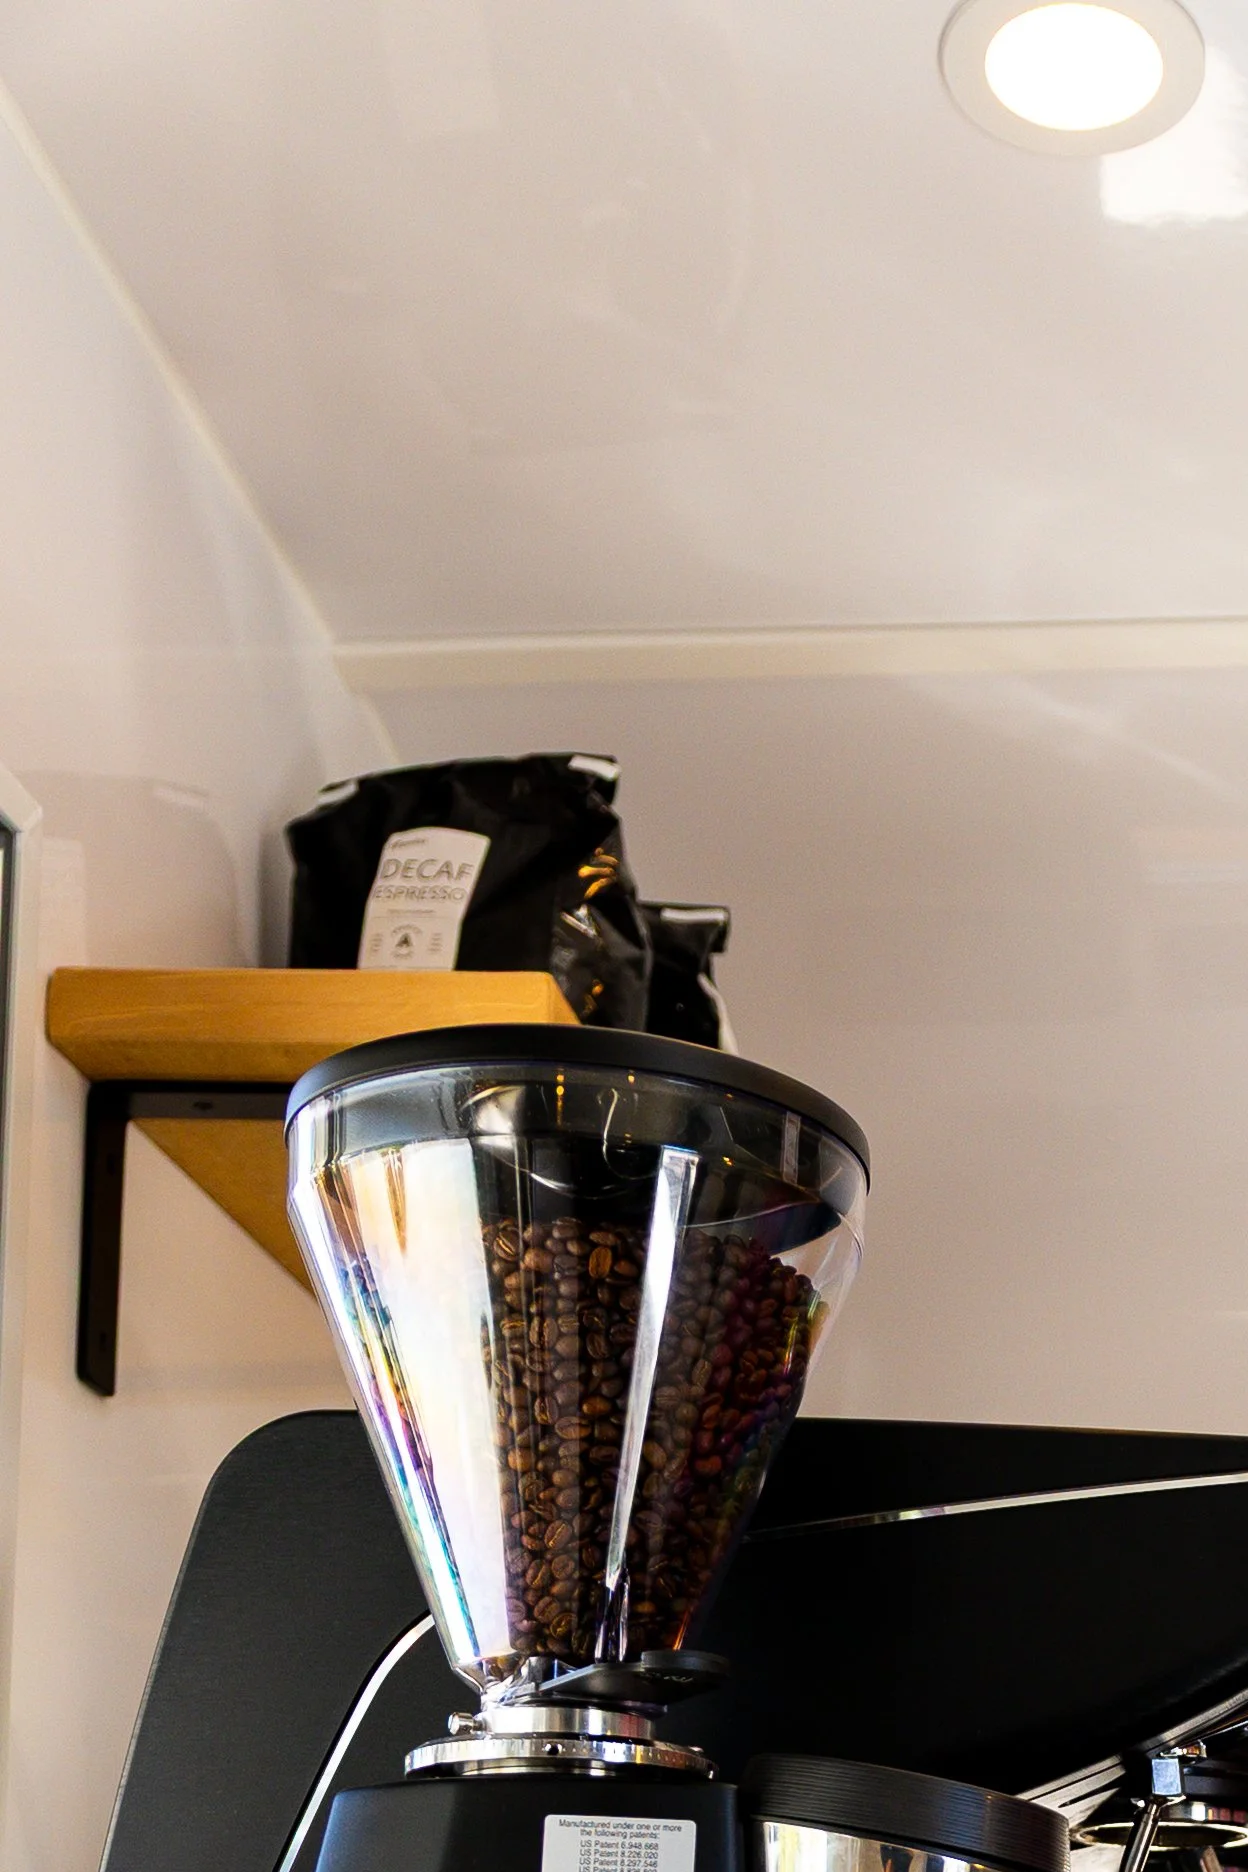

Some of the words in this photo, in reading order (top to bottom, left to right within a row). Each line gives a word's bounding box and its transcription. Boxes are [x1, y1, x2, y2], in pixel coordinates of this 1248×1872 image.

[381, 858, 474, 881] DECAF
[375, 885, 467, 902] ESPRESSO
[559, 1819, 610, 1828] Manufactured
[613, 1821, 634, 1829] under
[636, 1823, 651, 1831] one
[595, 1829, 627, 1840] following
[580, 1840, 592, 1848] US
[594, 1840, 619, 1849] Patent
[580, 1849, 592, 1857] US
[594, 1849, 618, 1857] Patent
[579, 1857, 591, 1865] US
[593, 1857, 617, 1866] Patent
